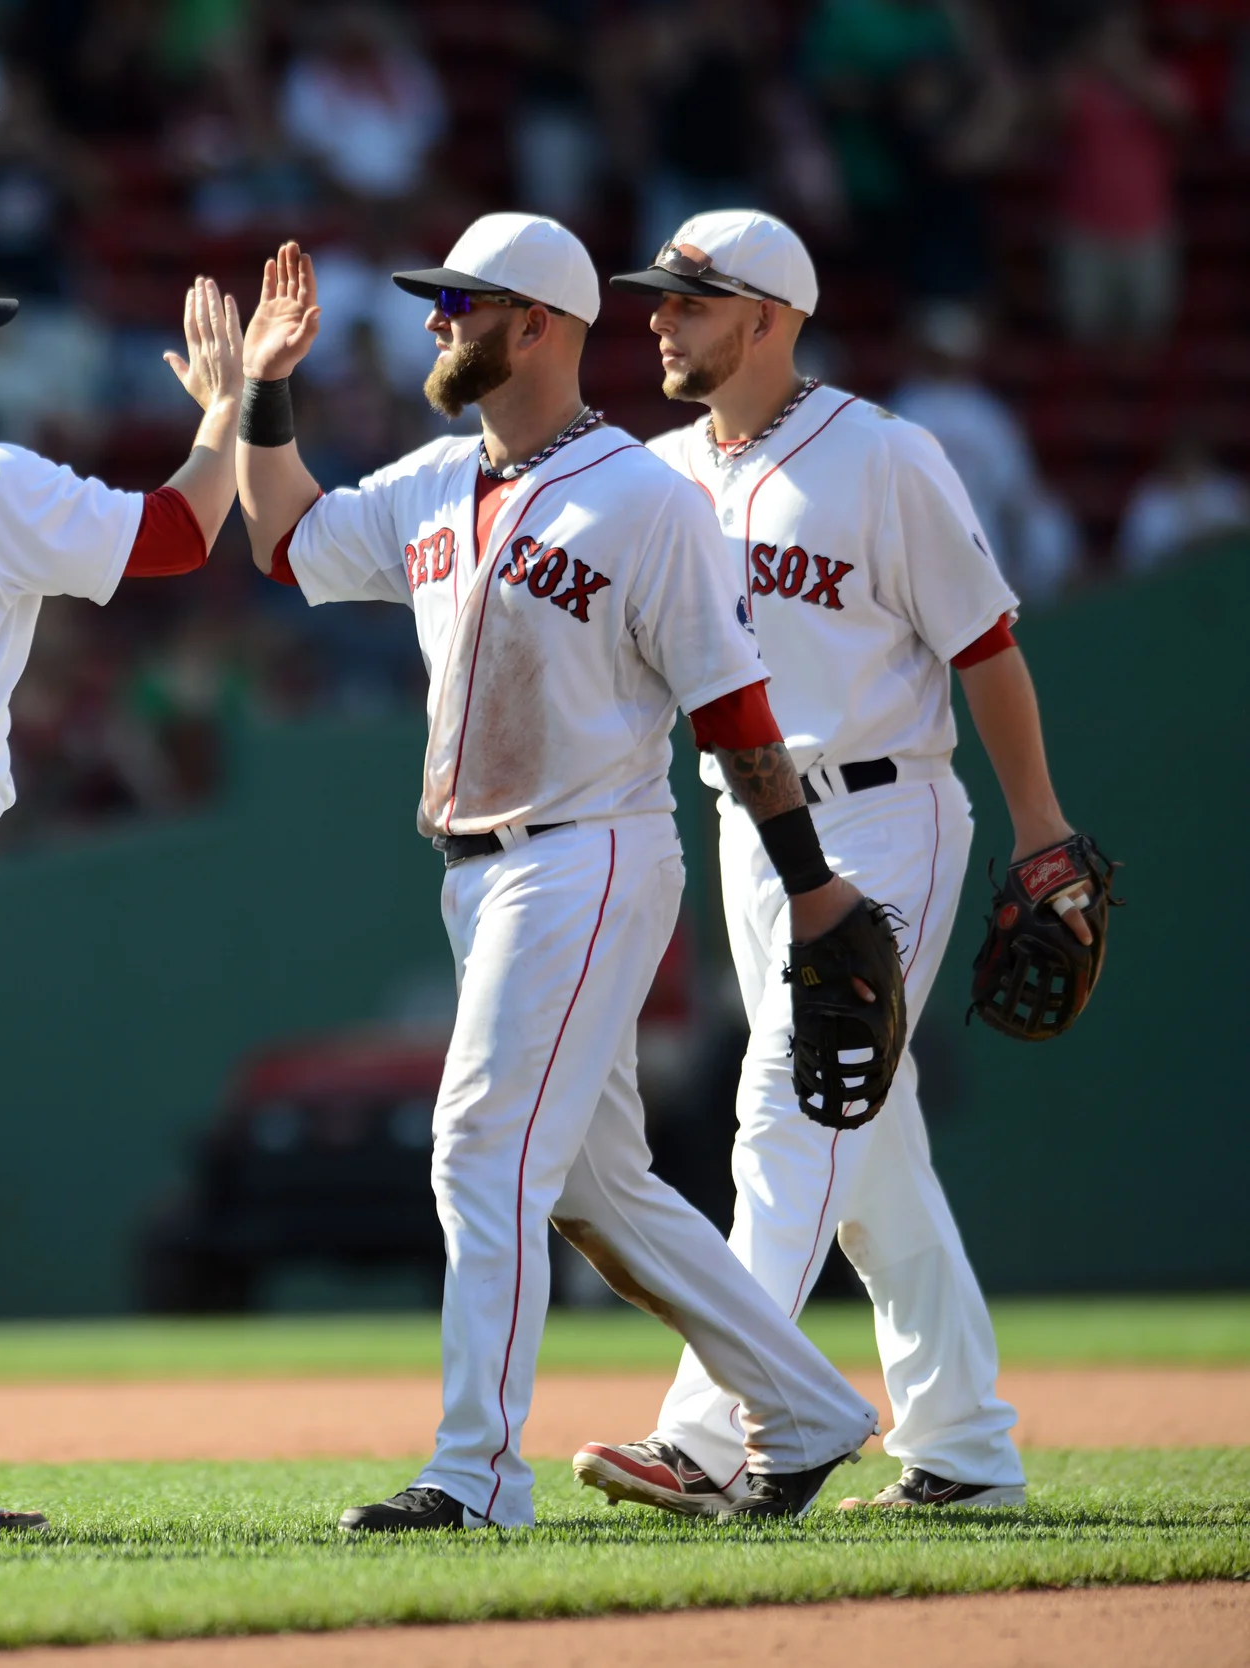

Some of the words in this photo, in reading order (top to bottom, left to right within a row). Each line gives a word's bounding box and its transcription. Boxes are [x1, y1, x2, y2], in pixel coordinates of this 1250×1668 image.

[404, 526, 455, 594] RED
[498, 535, 612, 623] SOX
[750, 543, 855, 611] SOX
